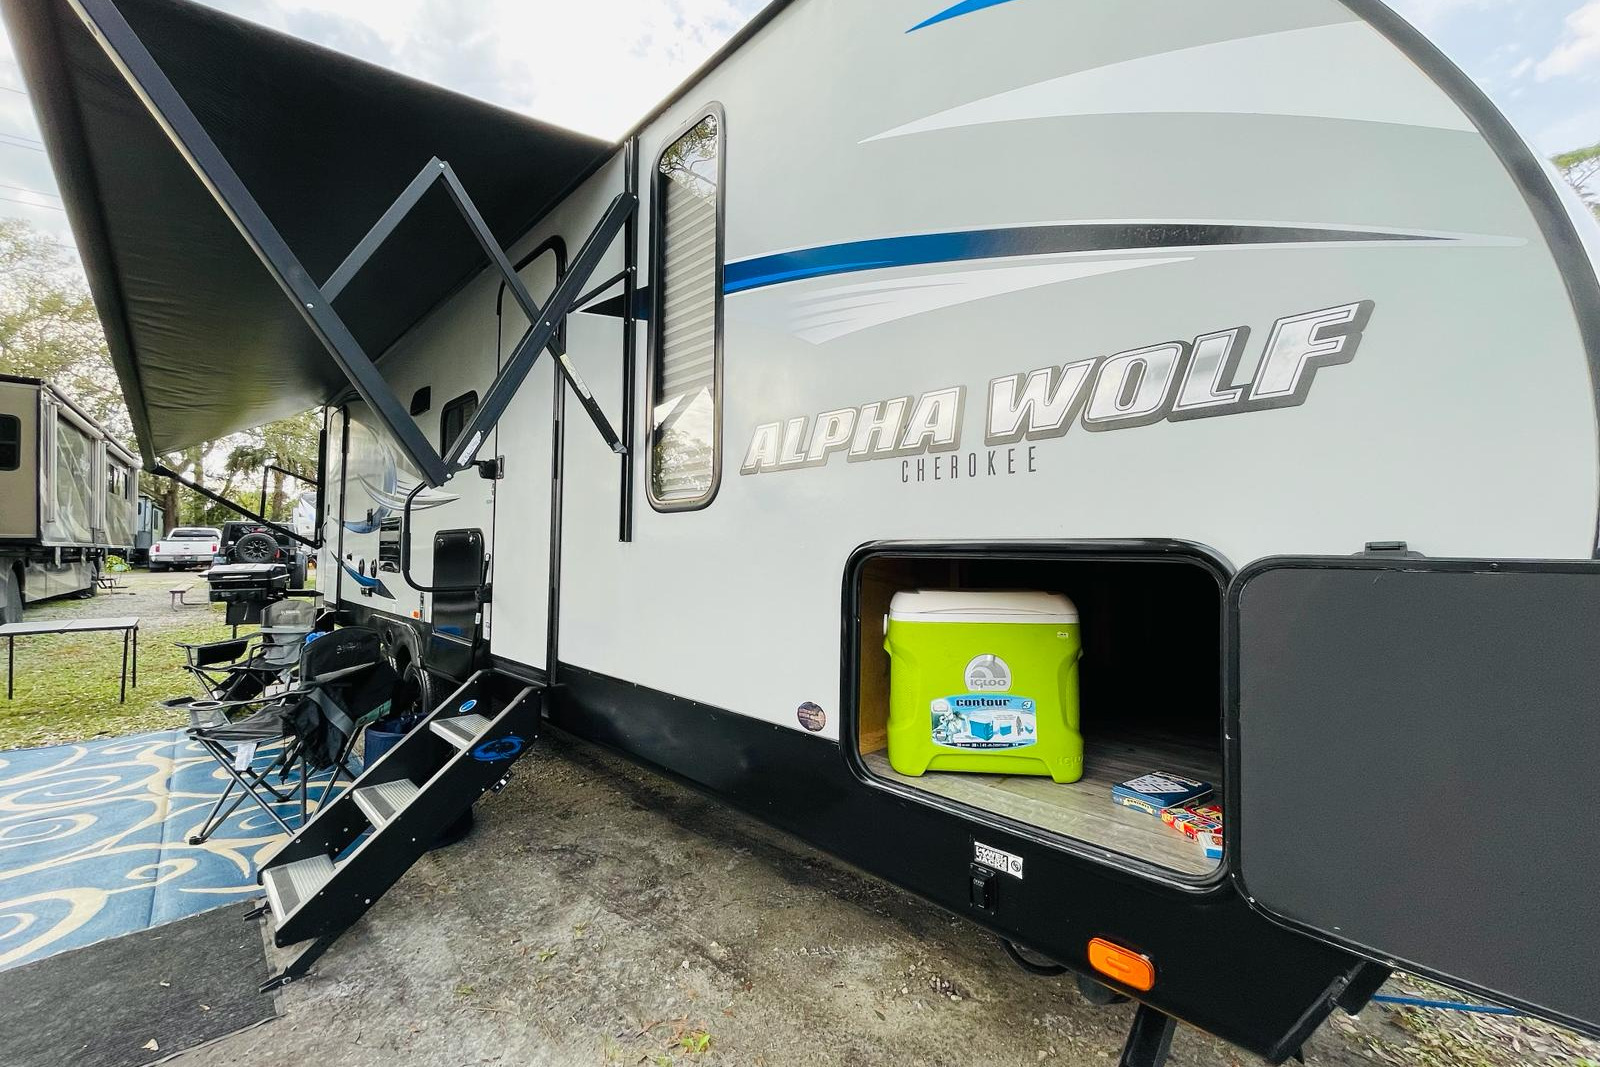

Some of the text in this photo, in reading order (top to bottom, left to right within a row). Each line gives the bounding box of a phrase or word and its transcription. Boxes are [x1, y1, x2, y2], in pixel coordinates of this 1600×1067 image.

[740, 300, 1375, 475] ALPHA WOLF
[901, 446, 1037, 483] CHEROKEE
[970, 679, 1006, 688] IGLOO
[956, 698, 1010, 707] contour
